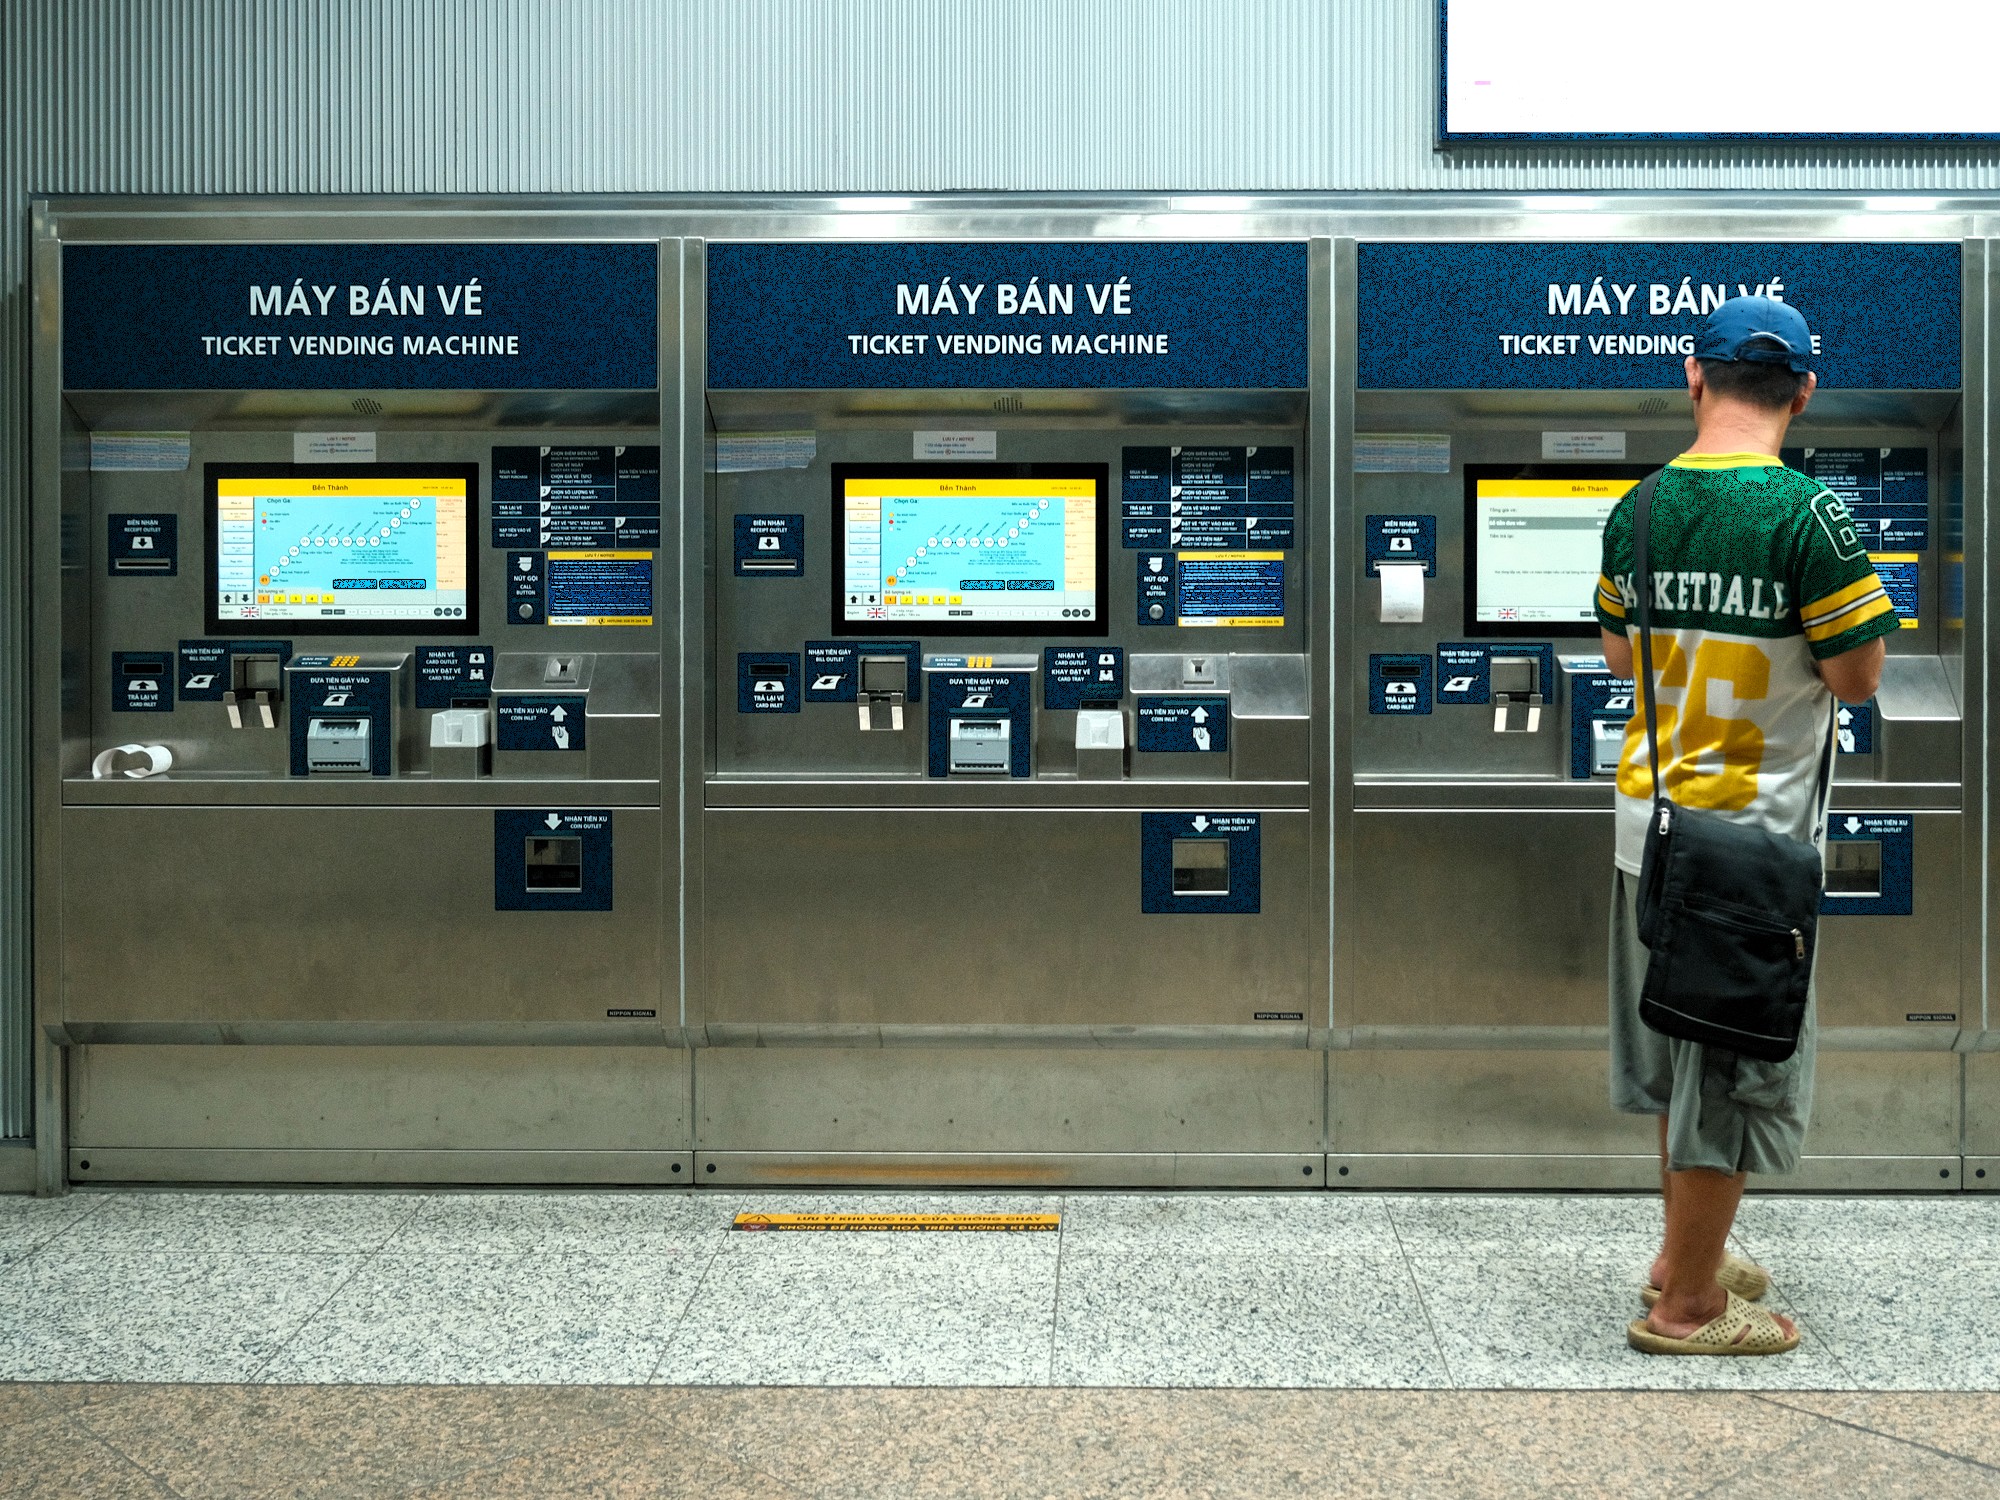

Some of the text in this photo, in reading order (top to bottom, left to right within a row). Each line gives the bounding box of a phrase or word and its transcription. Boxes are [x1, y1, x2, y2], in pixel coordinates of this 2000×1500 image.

[250, 278, 482, 315] MÁY BÁN VÉ
[897, 276, 1131, 315] MÁY BÁN VÉ
[1548, 276, 1637, 315] MÁY
[1650, 276, 1726, 315] BÁN
[202, 336, 518, 355] TICKET VENDING MACHINE
[848, 334, 1168, 354] TICKET VENDING MACHINE
[1499, 335, 1695, 355] TICKET VENDING
